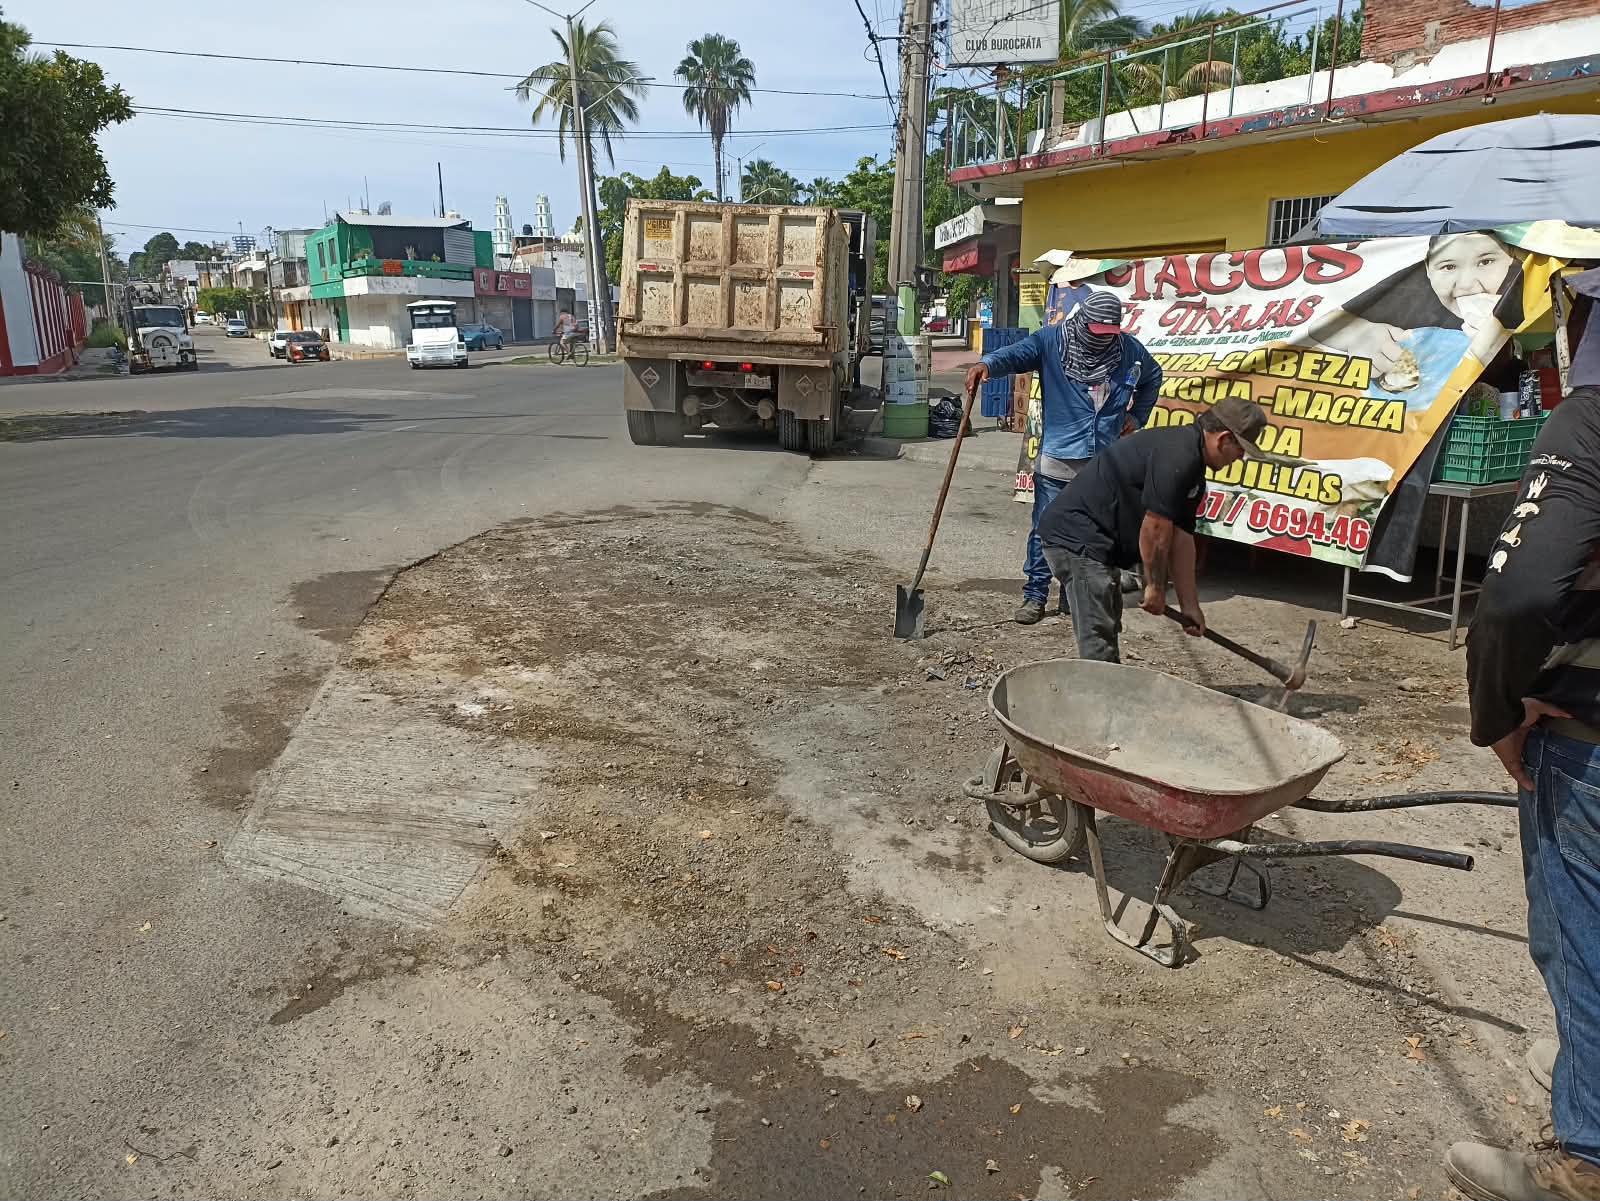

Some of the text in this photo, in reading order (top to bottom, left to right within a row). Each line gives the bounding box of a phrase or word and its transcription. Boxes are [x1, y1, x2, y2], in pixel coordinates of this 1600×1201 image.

[965, 39, 988, 51] CLUB
[1104, 242, 1364, 301] TACOS
[1158, 295, 1325, 337] TINAJAS
[1150, 349, 1373, 390] RIPA-CABEZA
[1158, 376, 1253, 405] NGUA
